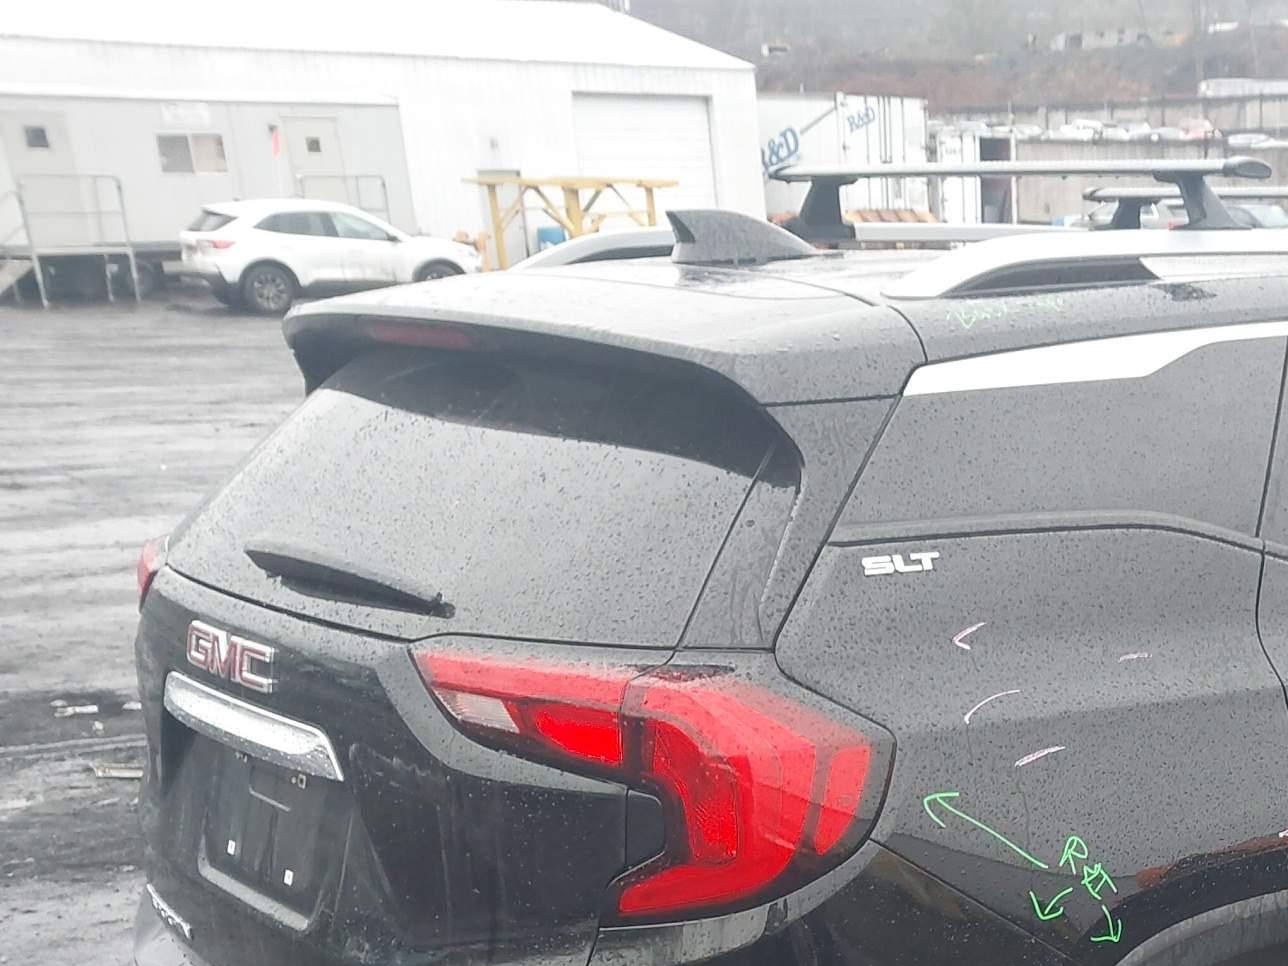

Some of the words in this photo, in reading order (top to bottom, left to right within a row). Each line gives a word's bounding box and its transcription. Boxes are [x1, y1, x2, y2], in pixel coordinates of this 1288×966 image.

[848, 106, 876, 132] R&D
[861, 551, 940, 576] SLT
[186, 619, 275, 694] GMC
